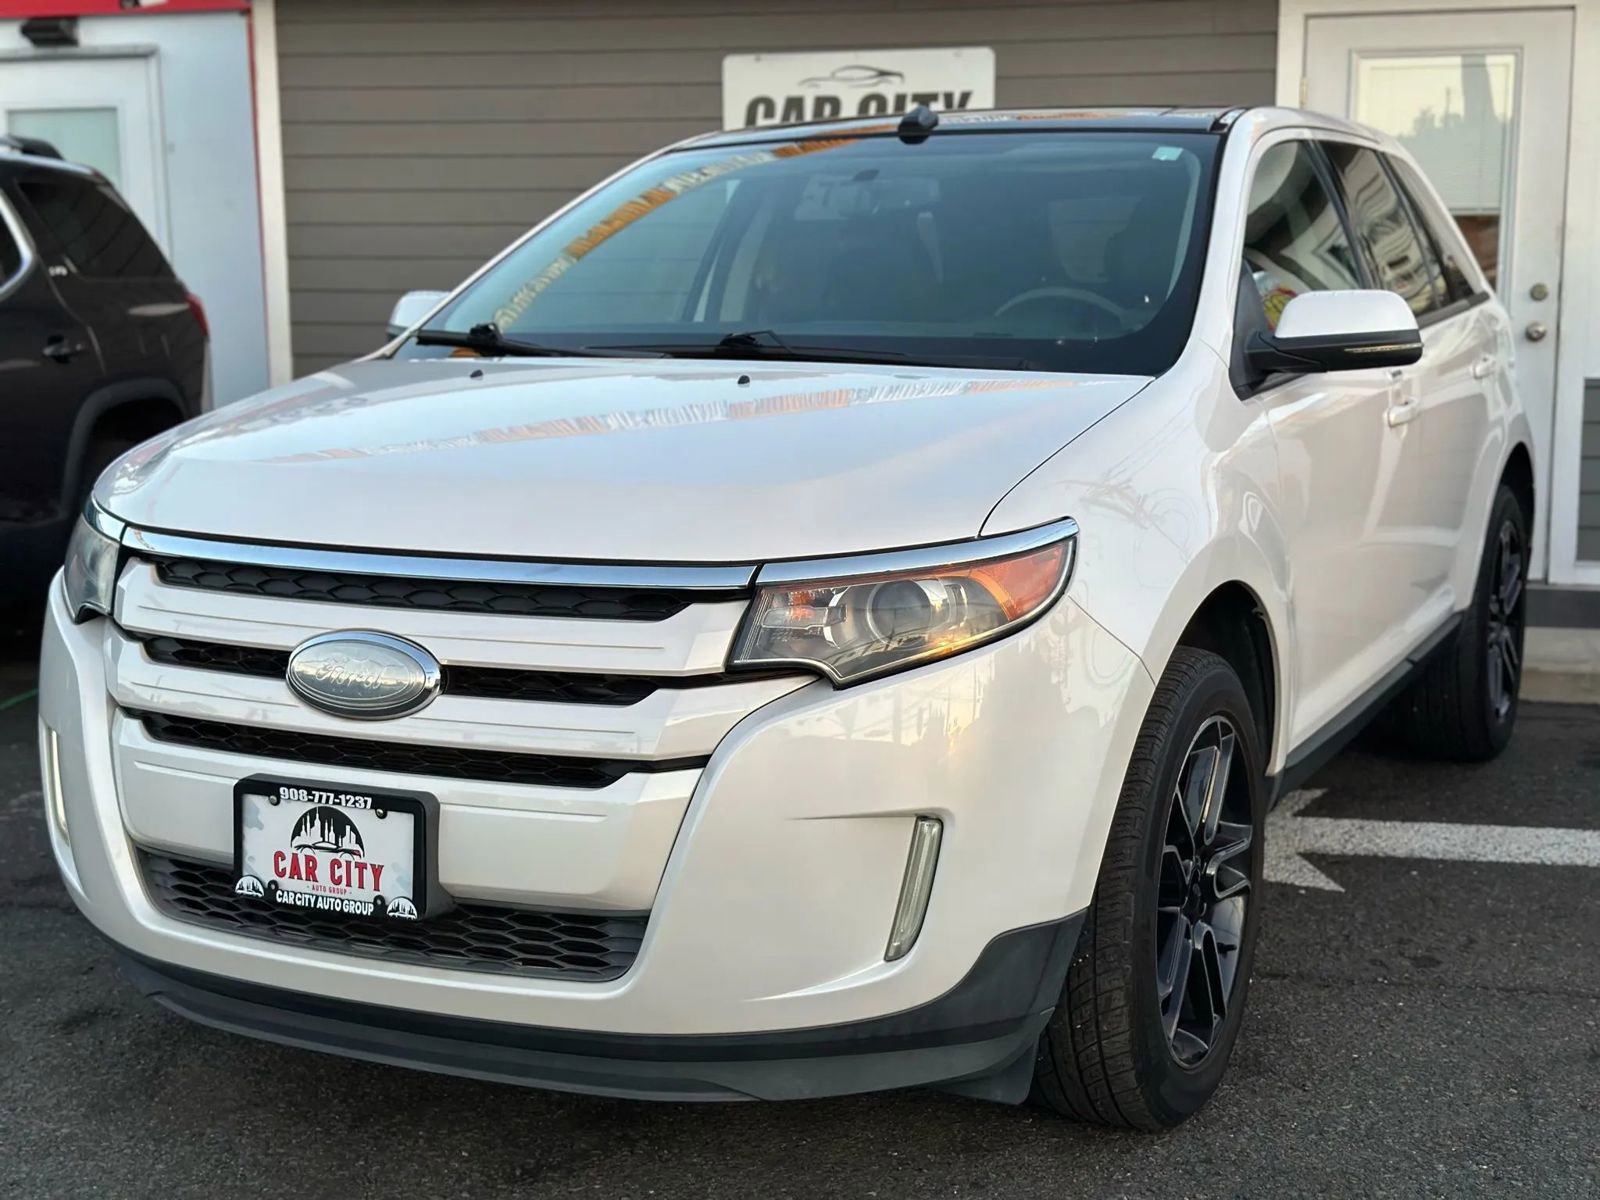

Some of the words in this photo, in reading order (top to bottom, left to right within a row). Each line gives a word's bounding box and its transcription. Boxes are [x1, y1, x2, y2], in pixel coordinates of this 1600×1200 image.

[279, 786, 372, 810] 908-777-1237
[273, 850, 319, 883] CAR
[329, 857, 385, 892] CITY
[311, 884, 327, 893] AUTO
[328, 886, 348, 895] GROUP
[276, 889, 295, 905] CAR
[295, 892, 317, 908] CITY
[317, 895, 342, 912] AUTO
[342, 899, 374, 916] GROUP
